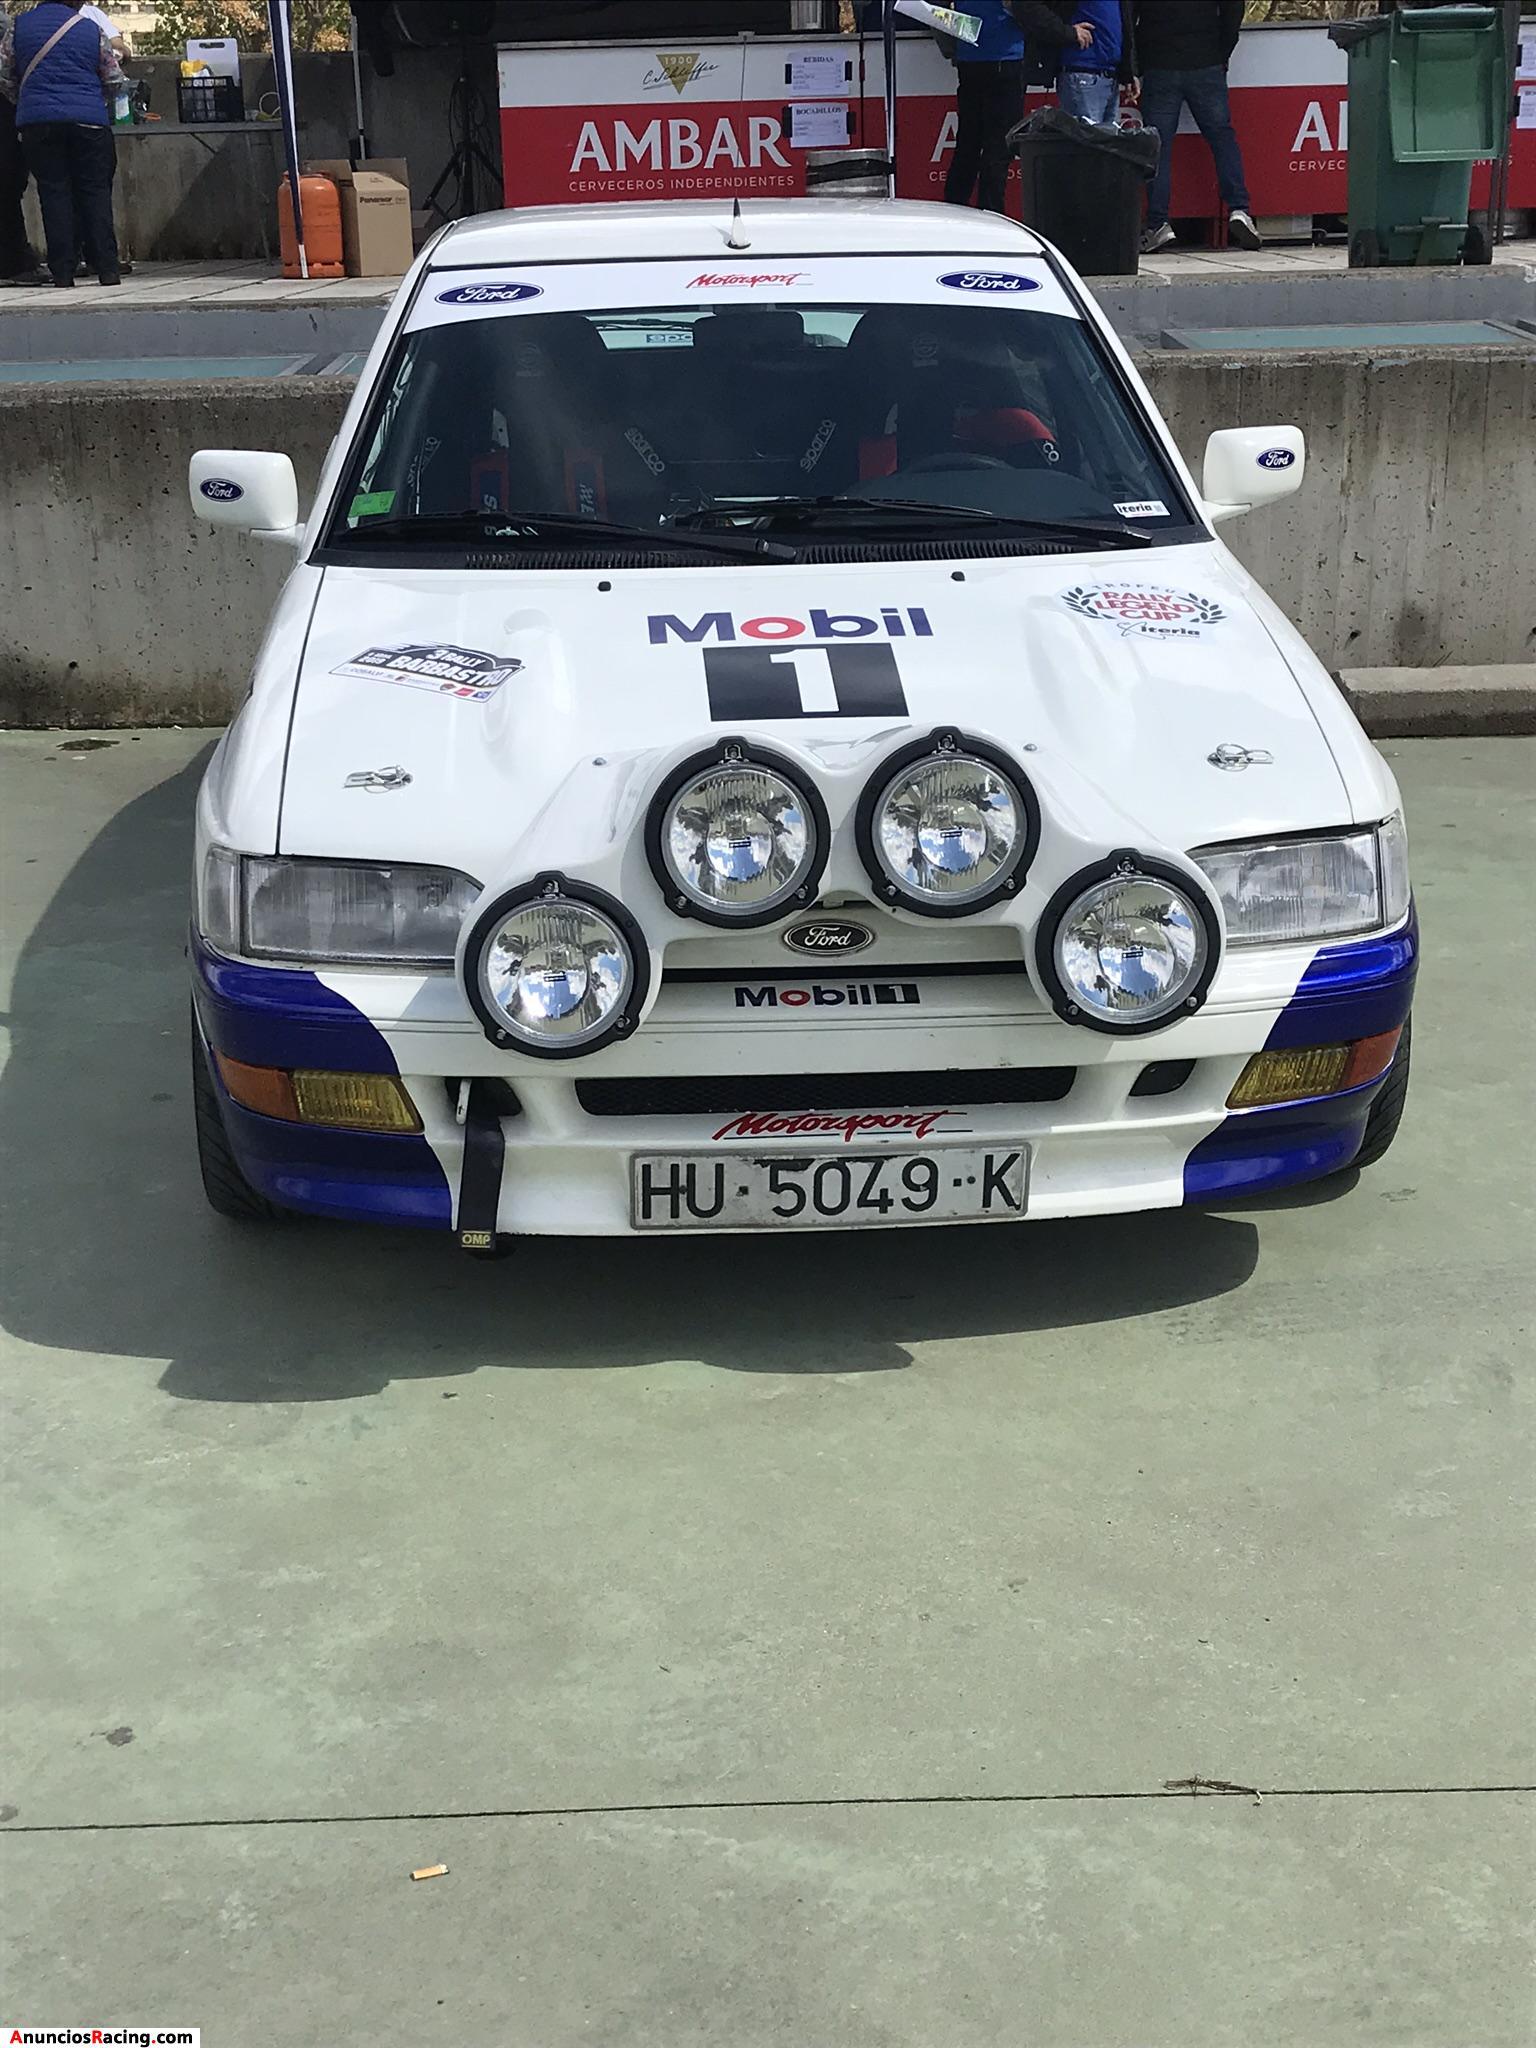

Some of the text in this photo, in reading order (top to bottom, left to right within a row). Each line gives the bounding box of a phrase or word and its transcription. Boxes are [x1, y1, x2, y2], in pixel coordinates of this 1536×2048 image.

[664, 56, 693, 65] 1900
[796, 107, 842, 115] BOCADILLOS
[569, 117, 792, 173] AMBAR
[1288, 160, 1347, 171] CERVEC
[569, 175, 795, 192] CERVECEROS INDEPENDIENTES
[685, 273, 803, 289] Motorsport
[960, 273, 1021, 289] Ford
[456, 285, 521, 302] Ford
[624, 427, 666, 474] sparco
[800, 419, 835, 473] sparco
[1265, 450, 1290, 467] Ford
[206, 480, 233, 498] Ford
[1102, 591, 1173, 602] RALLY
[1094, 600, 1196, 613] LEGEND
[1119, 610, 1182, 621] CUP
[647, 607, 934, 645] Mobil
[441, 651, 486, 668] RALLY
[769, 648, 840, 713] 1
[804, 926, 852, 947] Ford
[734, 984, 872, 1007] Mobil
[711, 1109, 949, 1143] Motorsport
[462, 1233, 491, 1245] OMP
